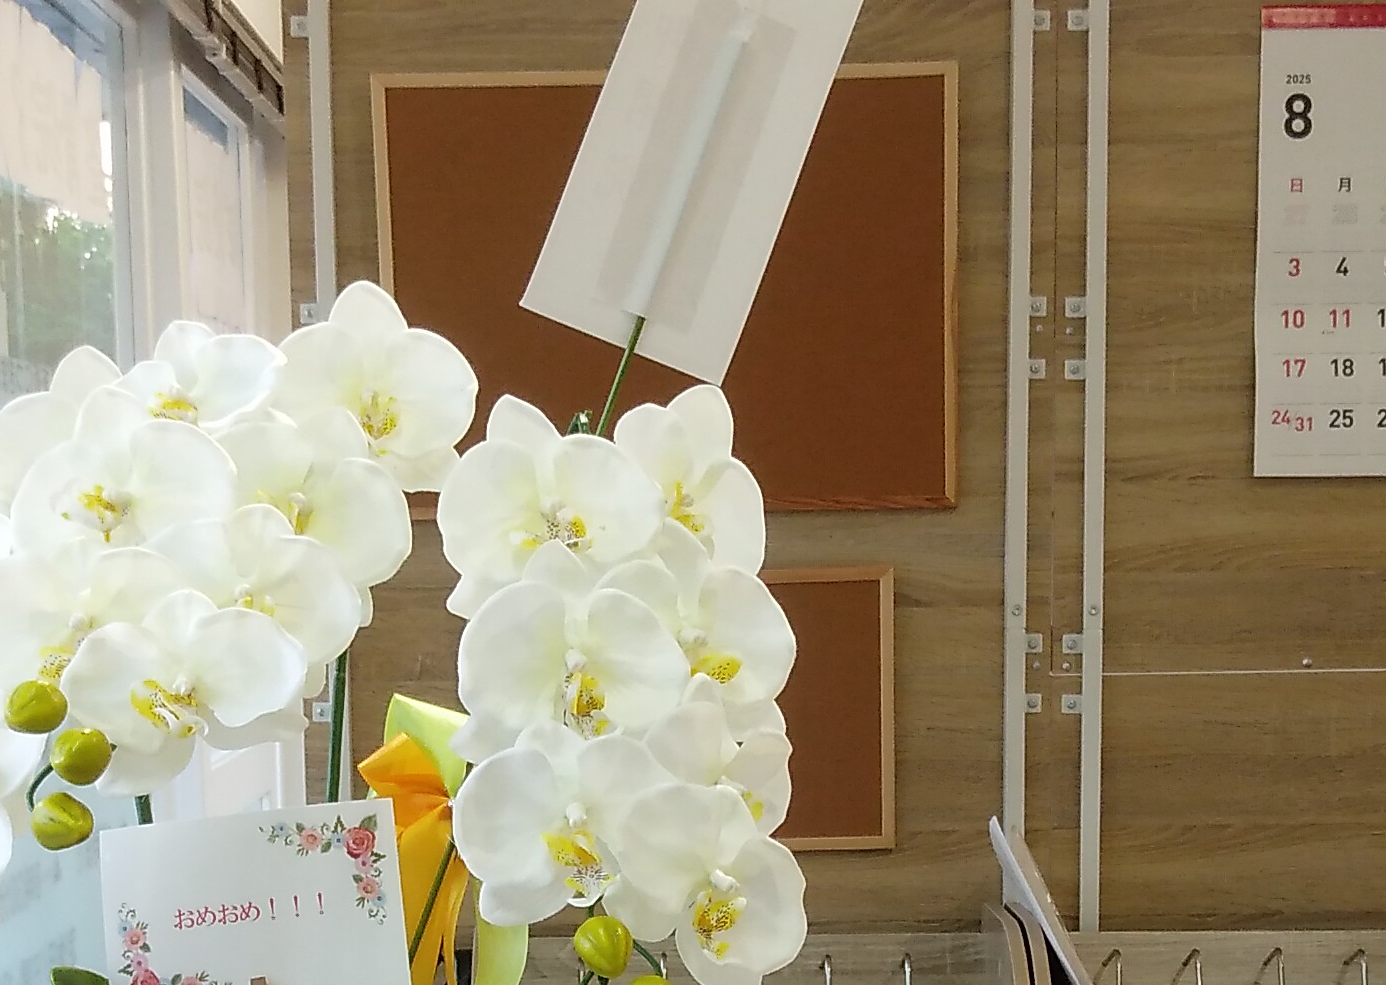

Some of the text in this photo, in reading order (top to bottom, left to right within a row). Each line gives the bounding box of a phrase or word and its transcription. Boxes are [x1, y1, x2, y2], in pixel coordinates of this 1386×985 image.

[1286, 74, 1311, 84] 2025
[1284, 94, 1312, 138] 8
[1291, 178, 1302, 192] 日
[1339, 178, 1351, 192] 月
[1289, 258, 1300, 276] 3
[1336, 257, 1348, 276] 4
[1281, 310, 1304, 328] 10
[1330, 309, 1349, 328] 11
[1283, 359, 1306, 377] 17
[1331, 359, 1354, 376] 18
[1272, 410, 1291, 424] 24
[1295, 417, 1312, 431] 31
[1329, 409, 1353, 428] 25
